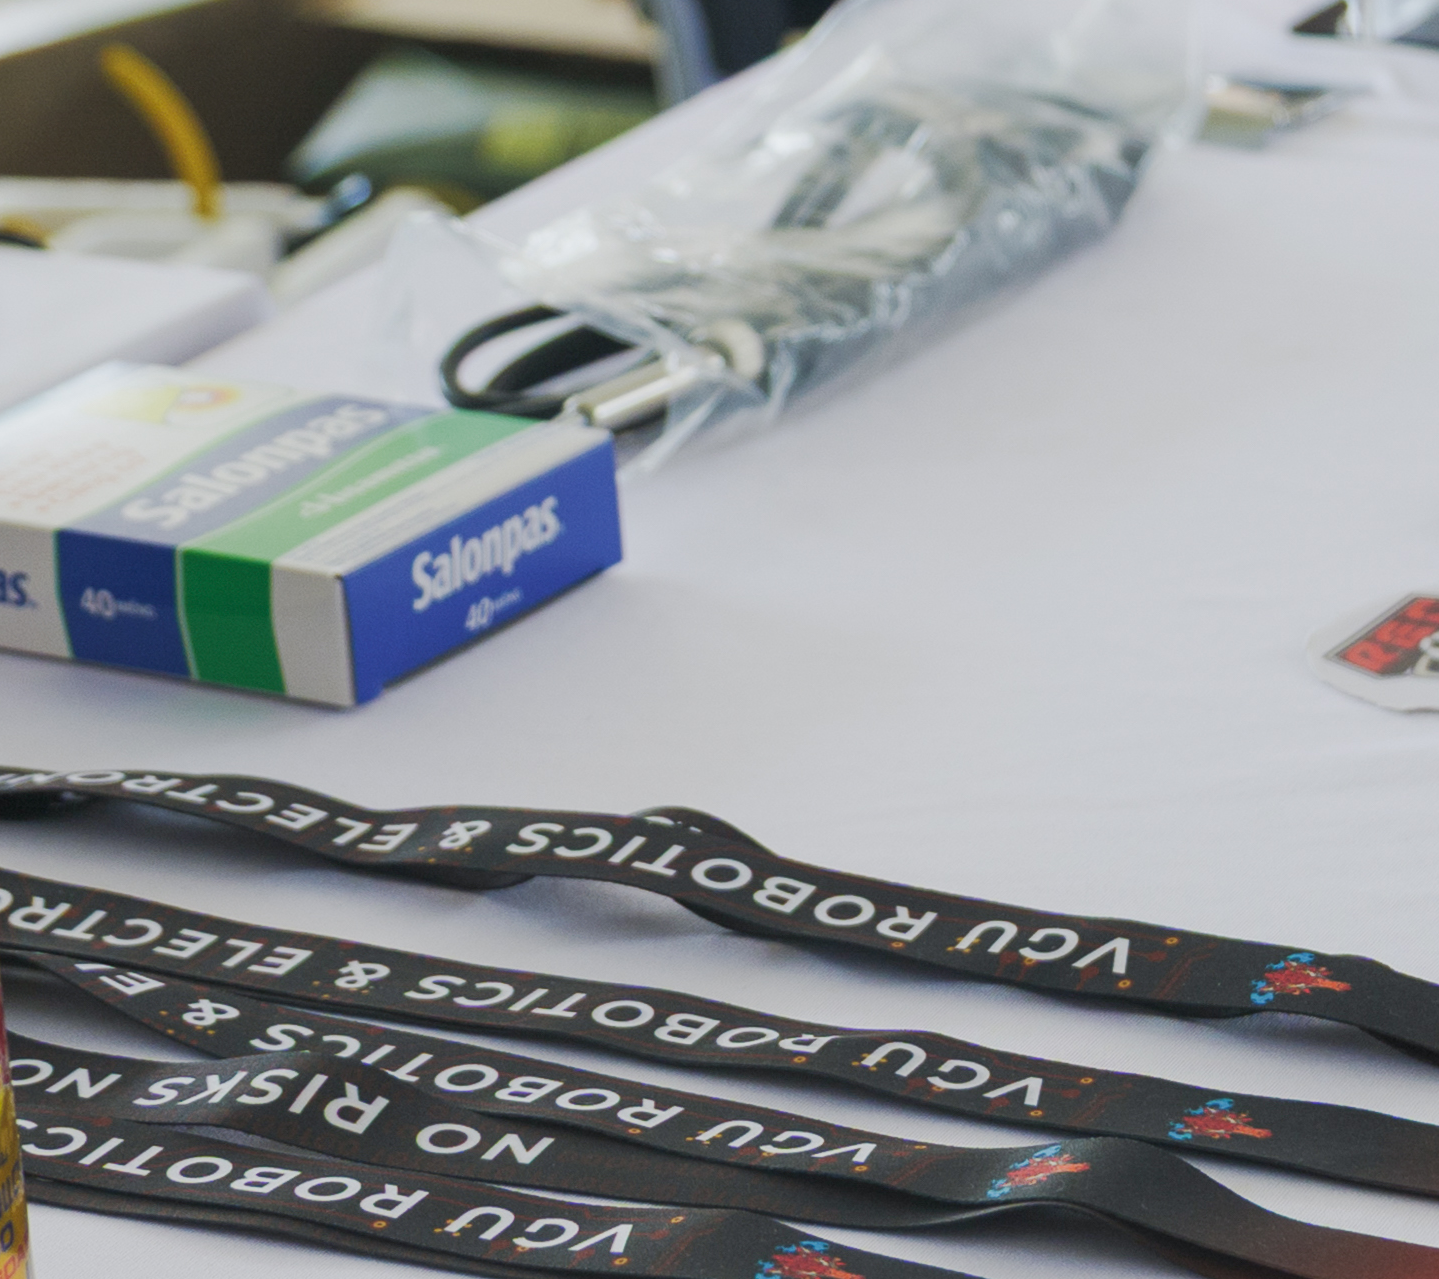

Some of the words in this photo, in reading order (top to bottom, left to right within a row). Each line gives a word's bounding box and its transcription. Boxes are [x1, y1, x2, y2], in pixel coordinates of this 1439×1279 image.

[121, 403, 391, 531] Salonpas
[412, 495, 561, 613] Salonpas
[436, 817, 492, 852] &
[506, 821, 940, 948] ROBOTICS
[335, 958, 392, 991] &
[955, 919, 1132, 978] VGU
[181, 997, 242, 1028] &
[404, 974, 844, 1057] ROBOTICS
[131, 1068, 391, 1136] RISKS
[860, 1039, 1046, 1108] VGU
[416, 1122, 556, 1165] NO
[705, 1119, 878, 1167] VGU
[443, 1205, 637, 1255] VGU
